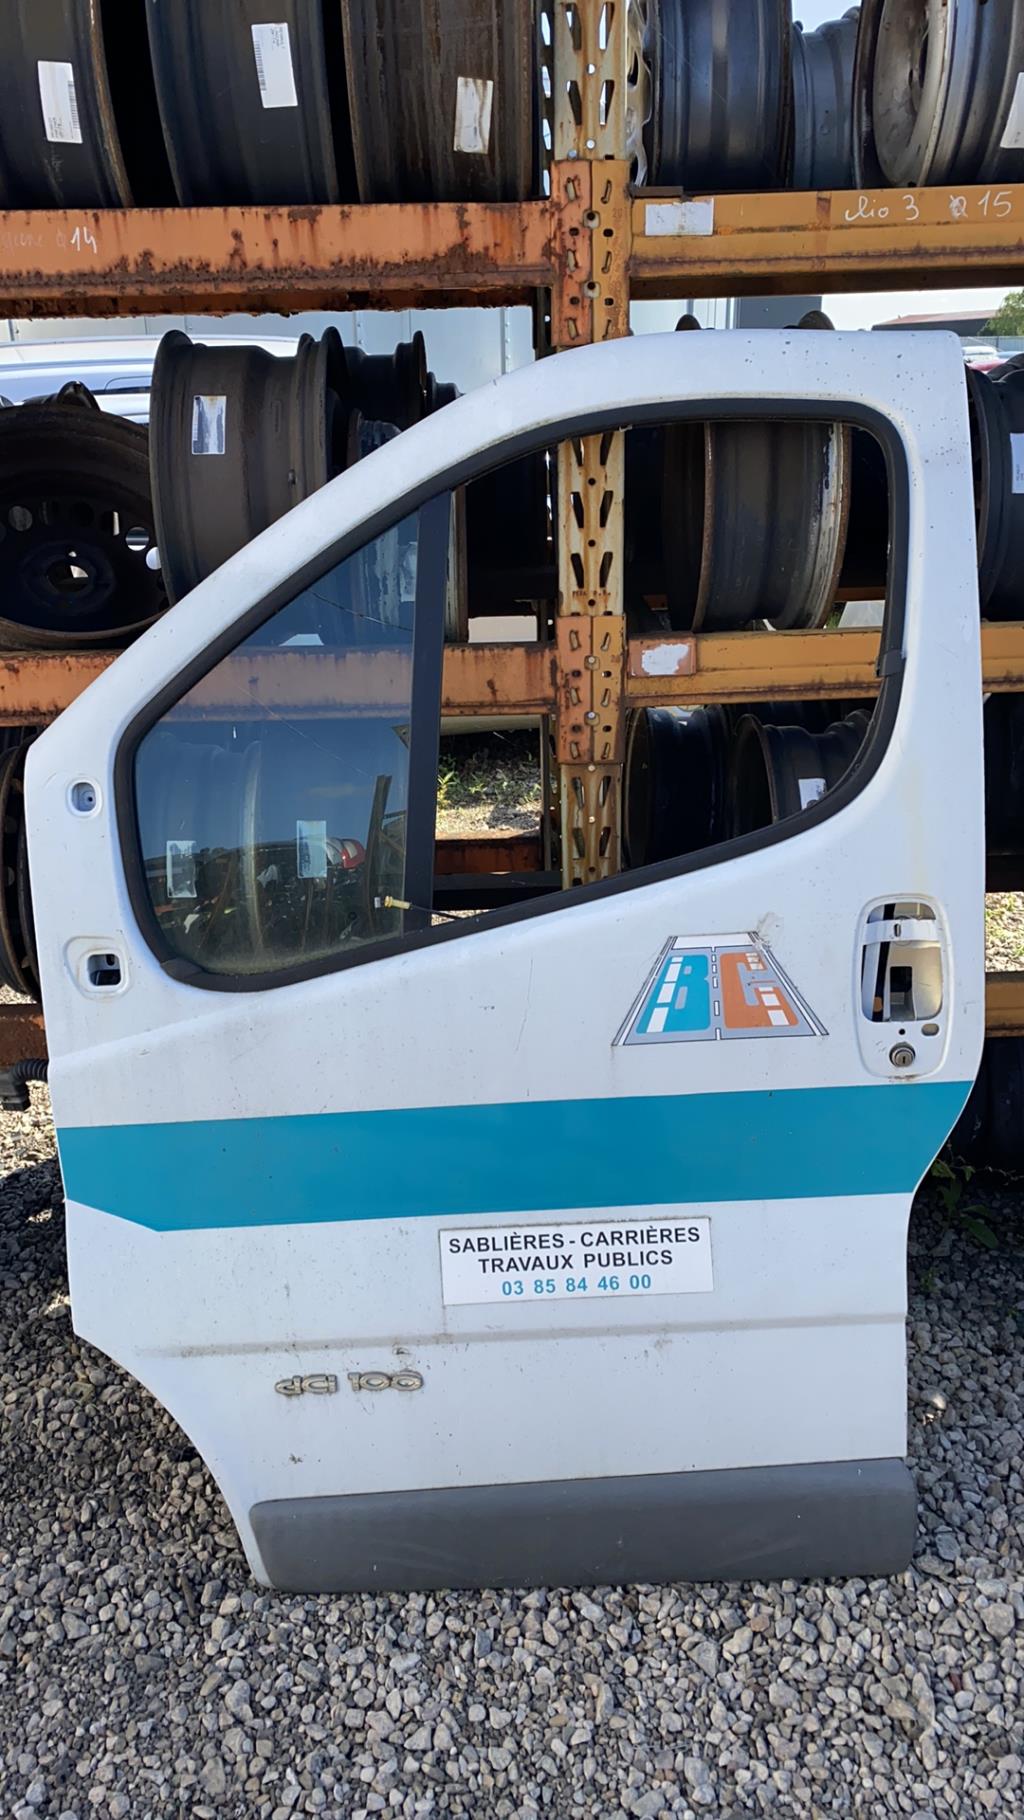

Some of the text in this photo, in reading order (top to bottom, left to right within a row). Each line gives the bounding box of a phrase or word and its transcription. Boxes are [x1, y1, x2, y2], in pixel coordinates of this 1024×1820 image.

[902, 194, 920, 221] 3
[977, 190, 1013, 217] 15
[70, 226, 97, 254] 14
[449, 1231, 564, 1254] SABLIÈRES
[580, 1225, 700, 1247] CARRIÈRES
[478, 1250, 673, 1274] TRAVAUX PUBLICS
[502, 1273, 651, 1296] 03 85 84 46 00
[347, 1369, 424, 1392] 100
